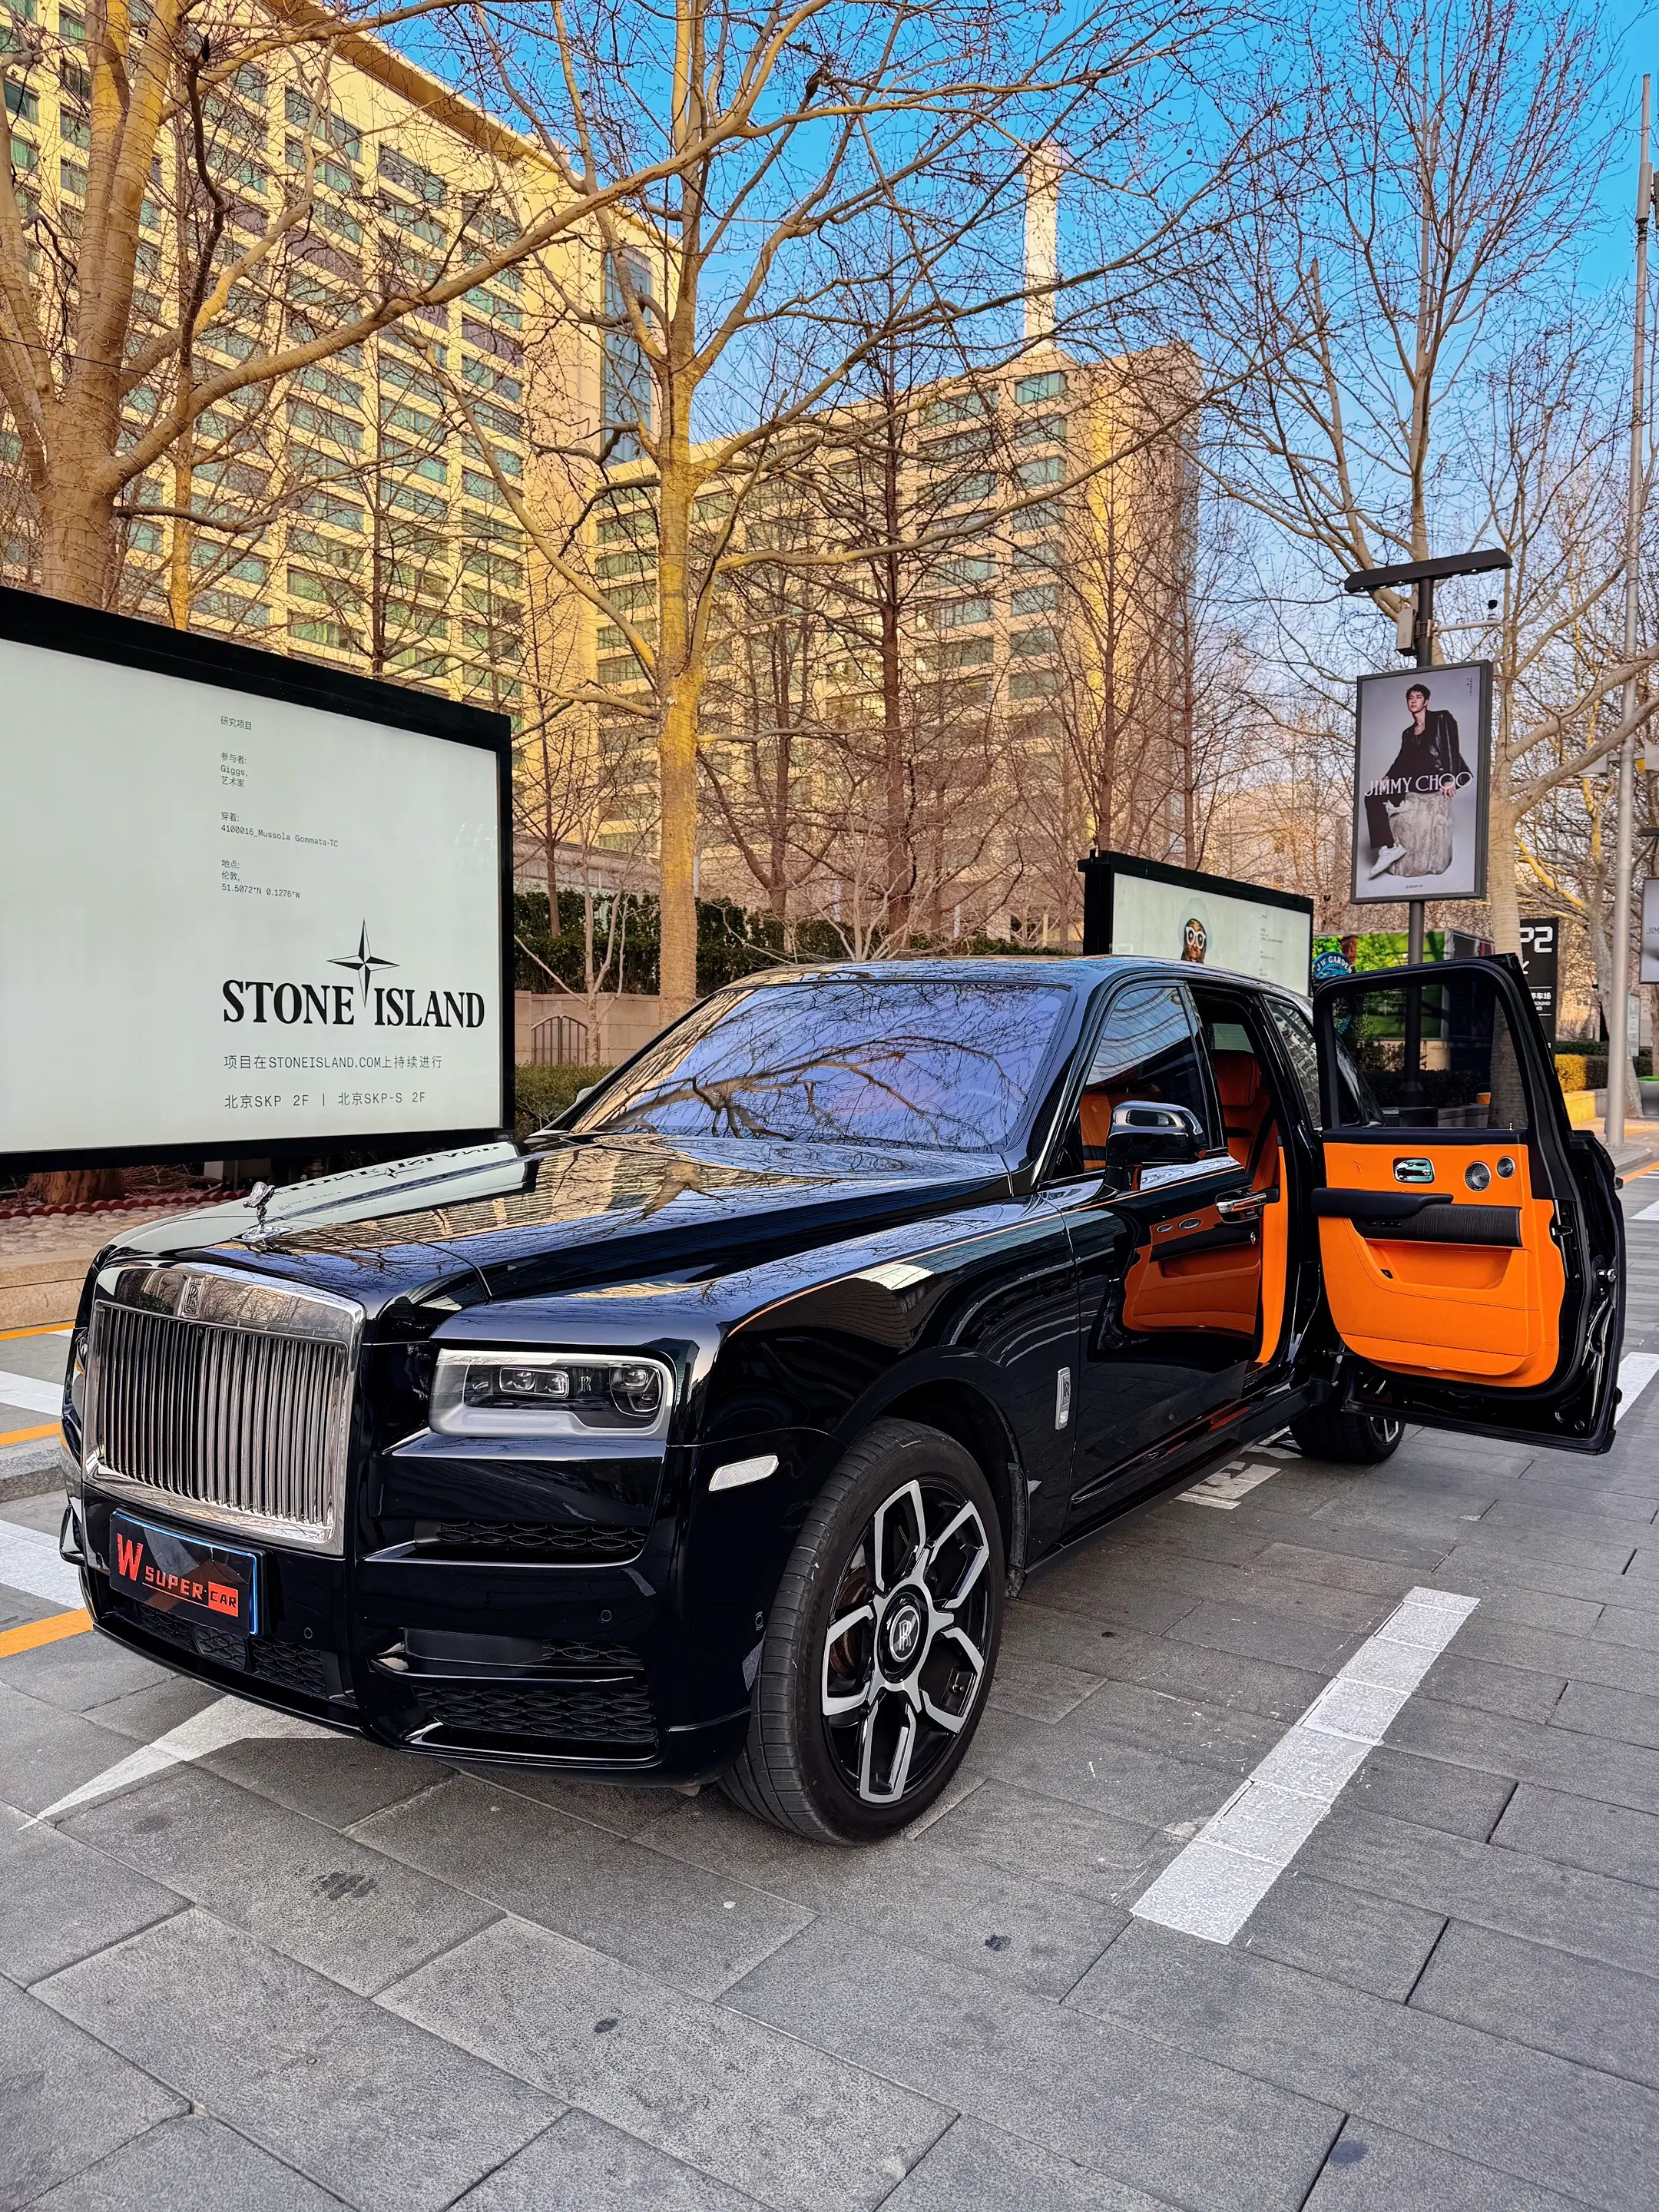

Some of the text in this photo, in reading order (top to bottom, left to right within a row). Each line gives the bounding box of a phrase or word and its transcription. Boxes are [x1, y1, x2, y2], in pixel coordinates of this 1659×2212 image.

[220, 716, 252, 730] 研究项目
[220, 764, 248, 777] Giggs,
[221, 776, 245, 788] 艺术家
[1364, 771, 1473, 796] JIMMY CHOO
[295, 834, 339, 848] Gommata-TC
[222, 979, 485, 1028] STONE ISLAND
[224, 1094, 282, 1109] 北京SKP
[293, 1094, 309, 1106] 2F
[412, 1091, 426, 1103] 2F
[117, 1532, 237, 1608] W SUPER CAR
